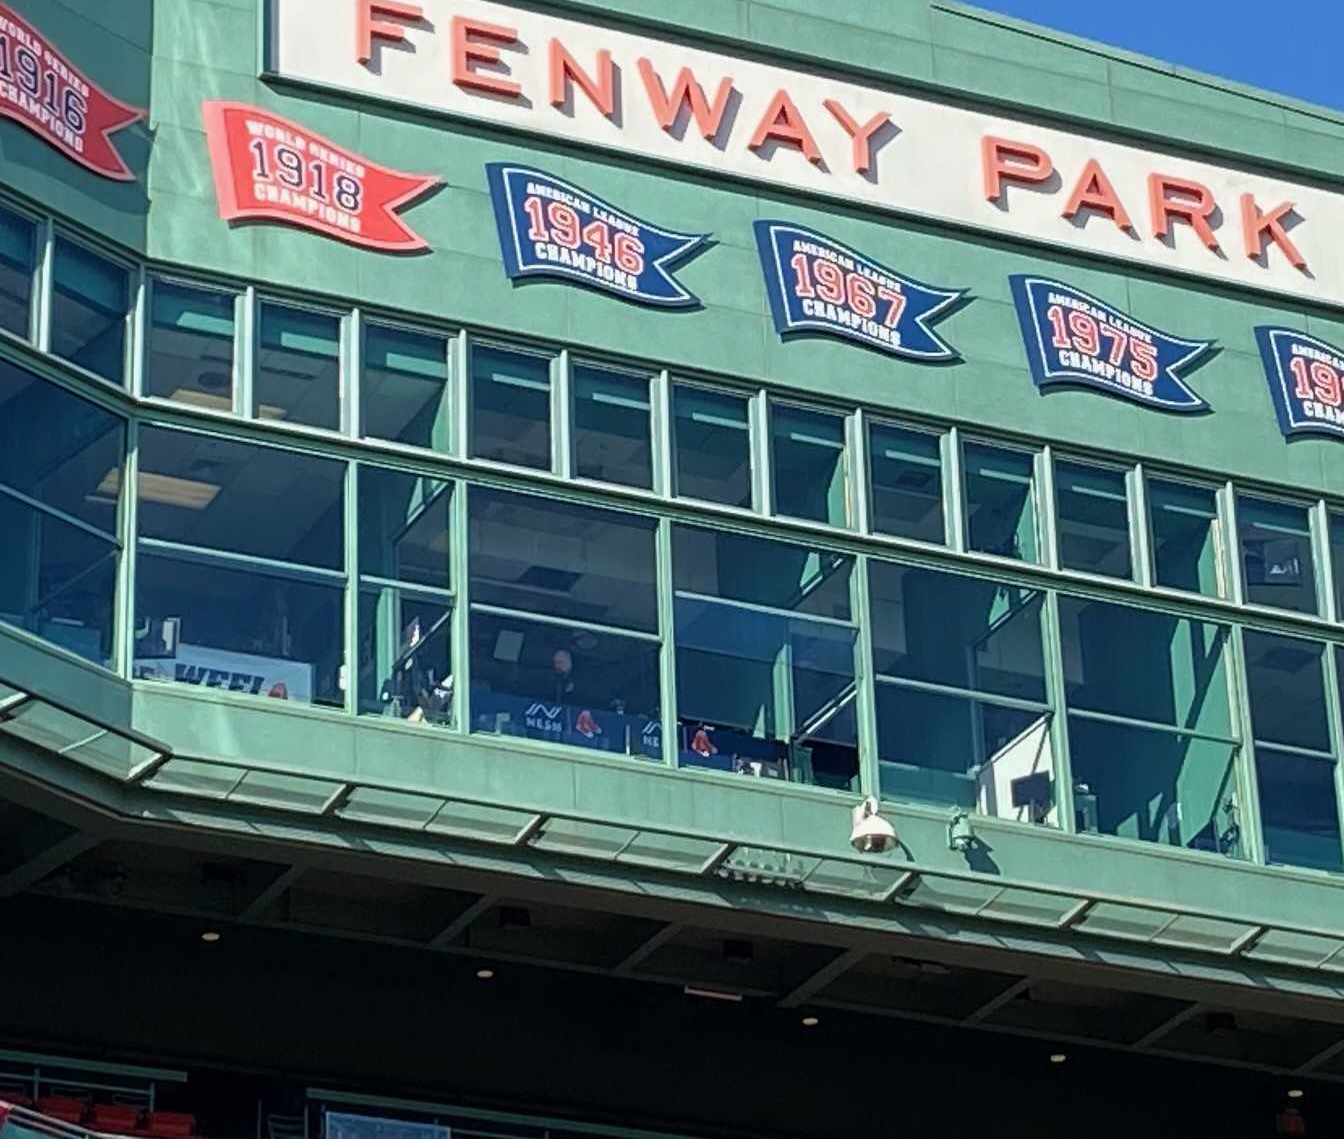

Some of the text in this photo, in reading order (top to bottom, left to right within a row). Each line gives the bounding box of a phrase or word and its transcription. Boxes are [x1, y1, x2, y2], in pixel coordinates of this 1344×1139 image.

[44, 50, 90, 98] SERIES
[245, 120, 366, 178] WORLD SERIES
[249, 137, 362, 213] 1918
[254, 181, 361, 232] CHAMPIONS
[526, 182, 640, 236] AMERICAN LEAGUE
[980, 134, 1308, 271] PARK
[524, 196, 645, 276] 1946
[534, 242, 638, 290] CHAMPIONS
[790, 253, 907, 328] 1967
[793, 240, 902, 293] AMERICAN LEAGUE
[802, 299, 902, 346] CHAMPIONS
[1047, 305, 1159, 382] 1975
[1048, 292, 1153, 343] AMERICAN LEAGUE
[1059, 349, 1154, 396] CHAMPIONS
